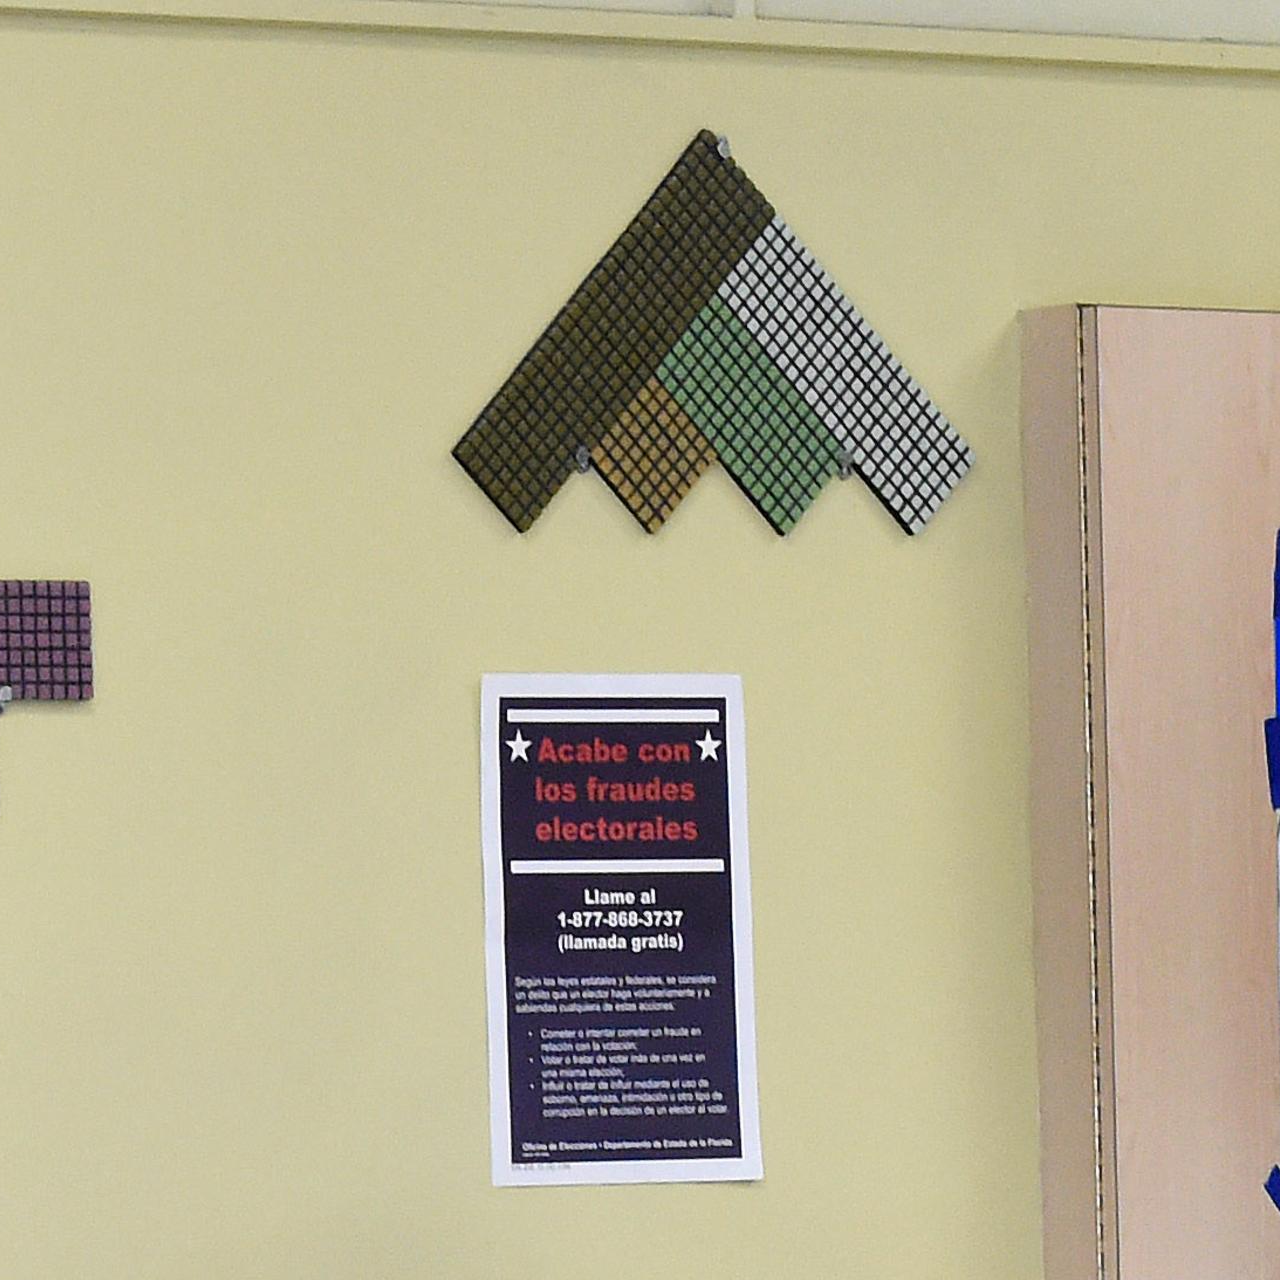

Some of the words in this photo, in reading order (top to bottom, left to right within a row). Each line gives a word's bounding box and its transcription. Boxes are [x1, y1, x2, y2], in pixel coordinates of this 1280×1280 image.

[538, 737, 629, 762] Acabe
[638, 743, 690, 762] con
[536, 777, 577, 801] los
[587, 776, 696, 801] fraudes
[536, 816, 698, 842] electorales
[584, 888, 635, 904] Llame
[640, 888, 656, 904] al
[557, 911, 683, 928] 1-877-868-3737
[558, 933, 627, 953] (llamada
[632, 932, 683, 952] gratis)
